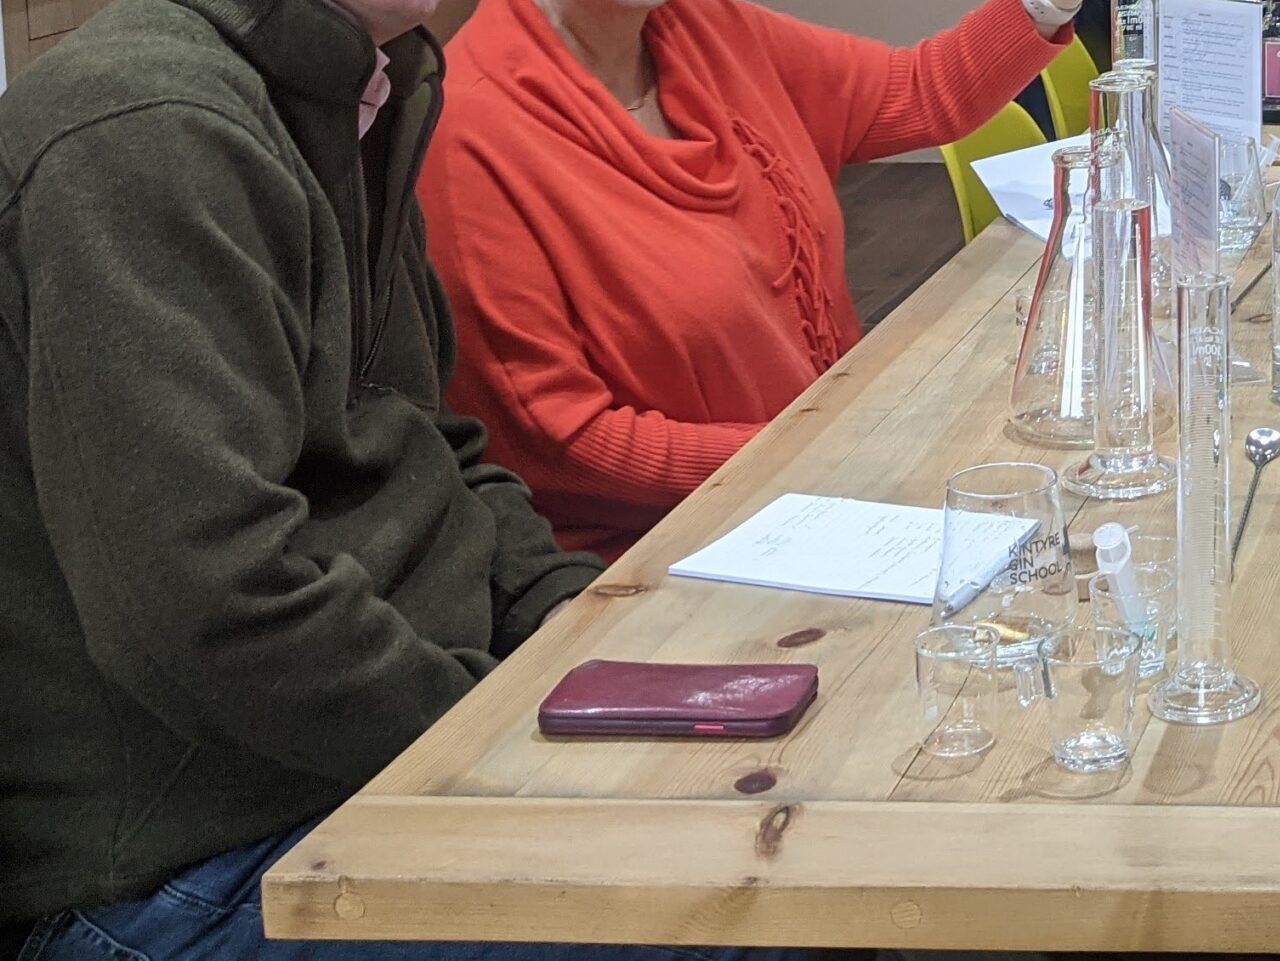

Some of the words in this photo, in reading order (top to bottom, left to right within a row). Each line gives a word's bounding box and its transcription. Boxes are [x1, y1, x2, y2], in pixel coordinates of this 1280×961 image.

[1008, 532, 1060, 558] KINTYRE
[1010, 556, 1033, 571] GIN
[1010, 561, 1062, 585] SCHOOL
